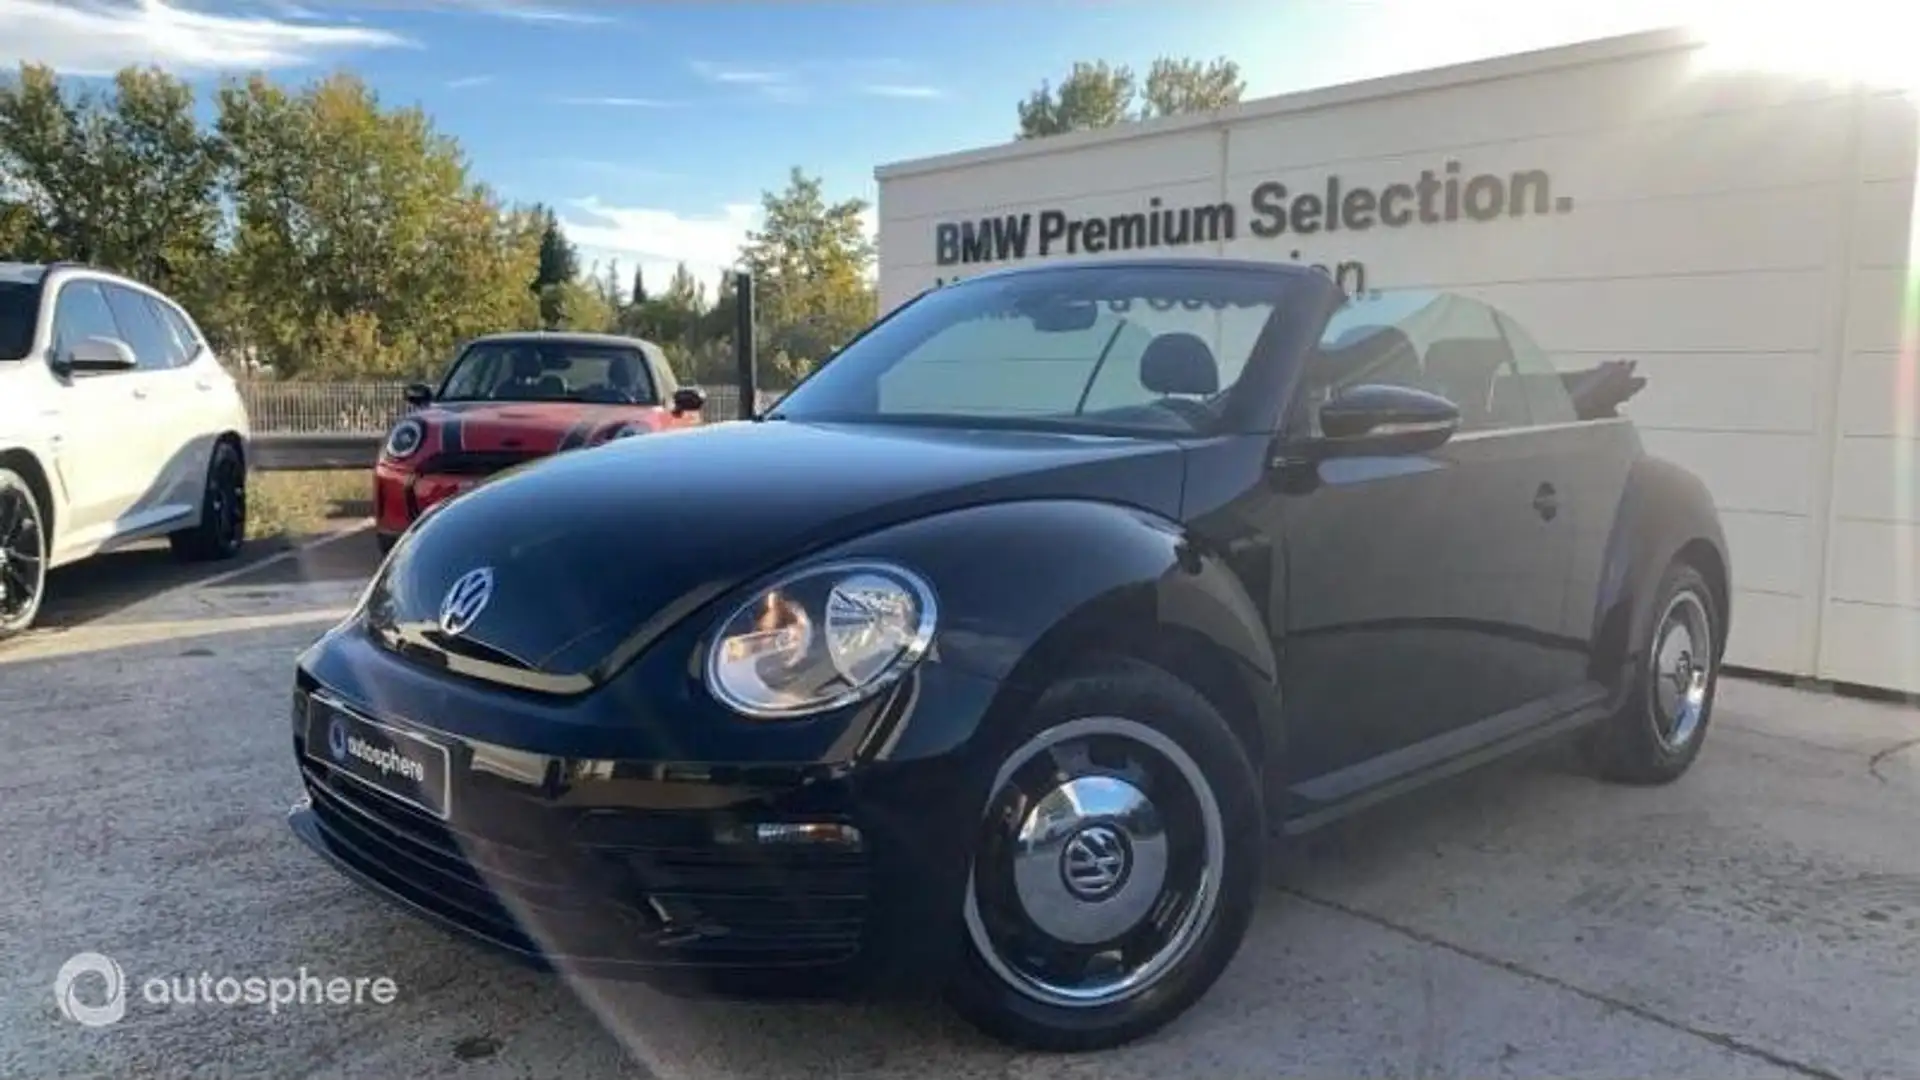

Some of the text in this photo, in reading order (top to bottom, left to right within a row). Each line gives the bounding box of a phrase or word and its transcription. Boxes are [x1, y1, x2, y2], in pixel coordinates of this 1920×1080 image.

[936, 161, 1574, 265] BMW Premium Selection.
[347, 736, 424, 782] autosphere
